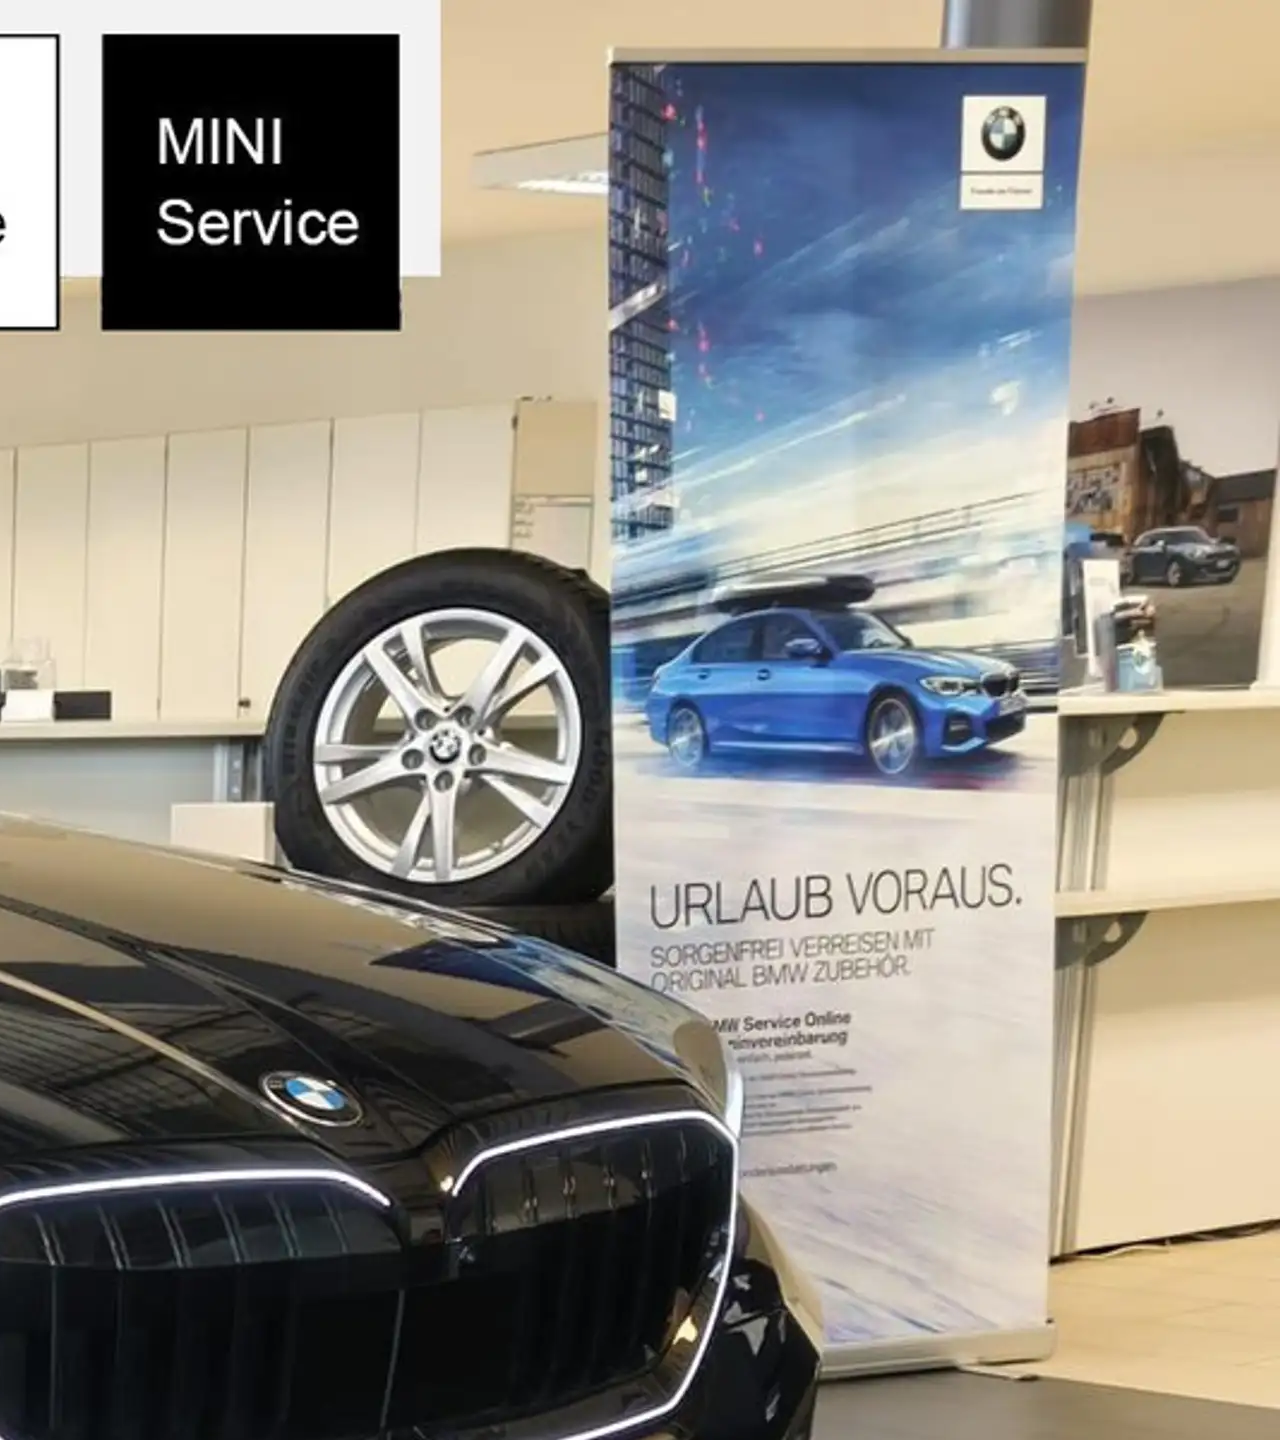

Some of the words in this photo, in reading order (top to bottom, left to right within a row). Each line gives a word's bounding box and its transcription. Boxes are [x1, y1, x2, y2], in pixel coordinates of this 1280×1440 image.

[650, 873, 833, 930] URLAUB
[845, 862, 1023, 916] VORAUS.
[650, 938, 785, 969] SORGENFREI
[790, 931, 899, 959] VERREISEN
[902, 928, 936, 951] MIT
[650, 966, 747, 995] ORIGINAL
[752, 962, 809, 987] BMW
[712, 1016, 741, 1034] MW
[743, 1014, 801, 1033] Service
[805, 1010, 853, 1028] Online
